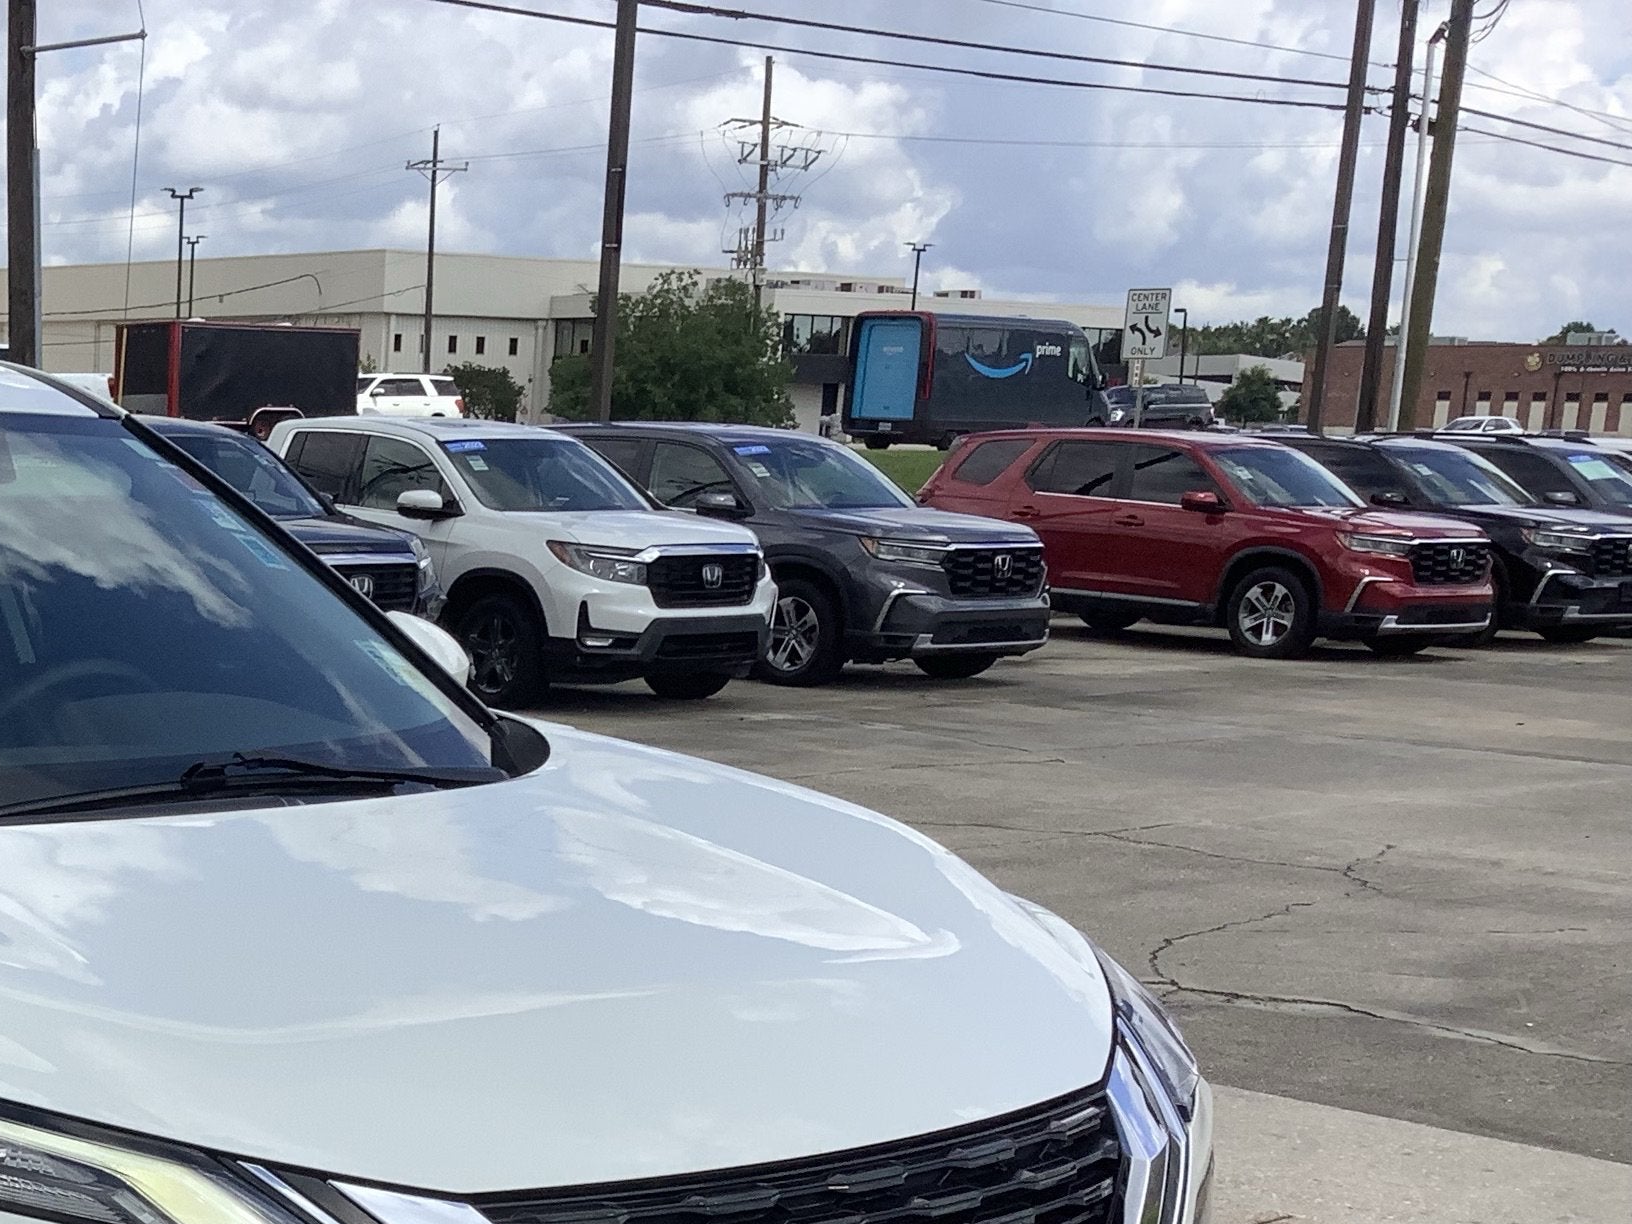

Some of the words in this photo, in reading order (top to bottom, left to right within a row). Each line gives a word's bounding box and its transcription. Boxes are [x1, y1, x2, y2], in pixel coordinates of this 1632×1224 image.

[1131, 292, 1167, 302] CENTER
[1135, 303, 1160, 312] LANE
[1035, 341, 1062, 358] prime
[1130, 346, 1156, 356] ONLY
